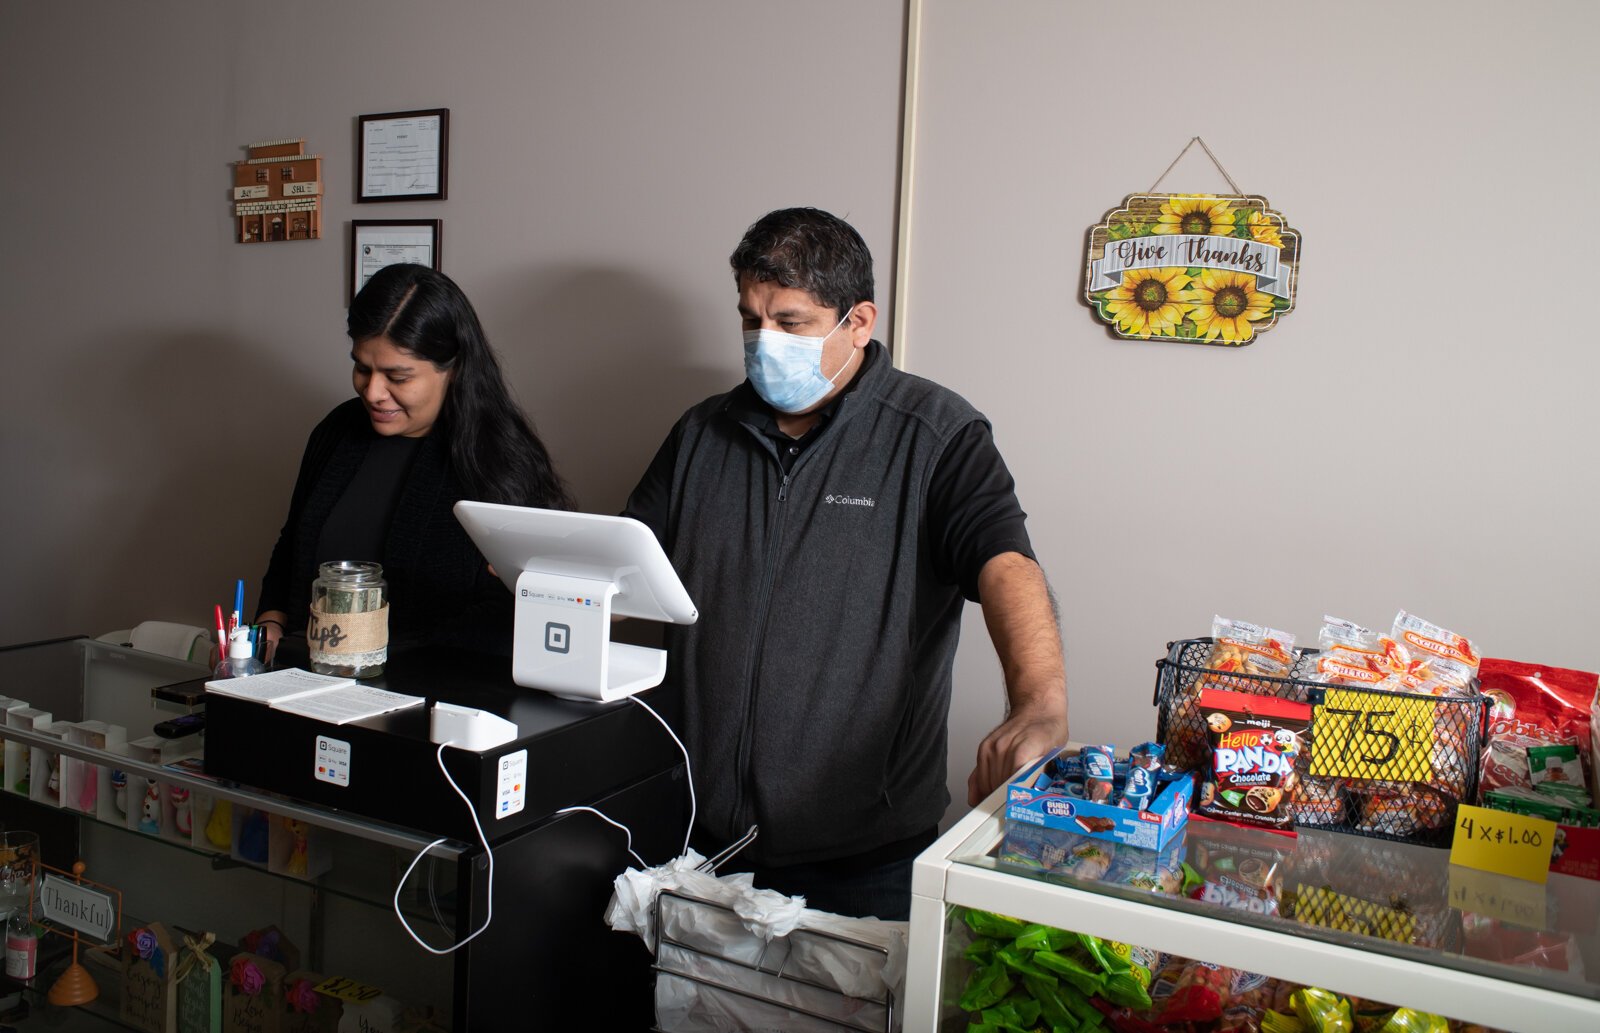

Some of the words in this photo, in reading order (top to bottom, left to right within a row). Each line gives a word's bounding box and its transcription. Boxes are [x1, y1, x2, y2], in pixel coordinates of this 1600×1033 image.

[1112, 241, 1168, 267] Give
[835, 494, 875, 507] Columbia
[1409, 634, 1462, 657] CACHITOS
[1246, 719, 1271, 728] meiji
[1220, 732, 1258, 748] Hello
[1215, 746, 1292, 776] PANDA
[1230, 773, 1271, 784] Chocolate
[1461, 818, 1474, 840] 4
[45, 886, 110, 930] Thankful
